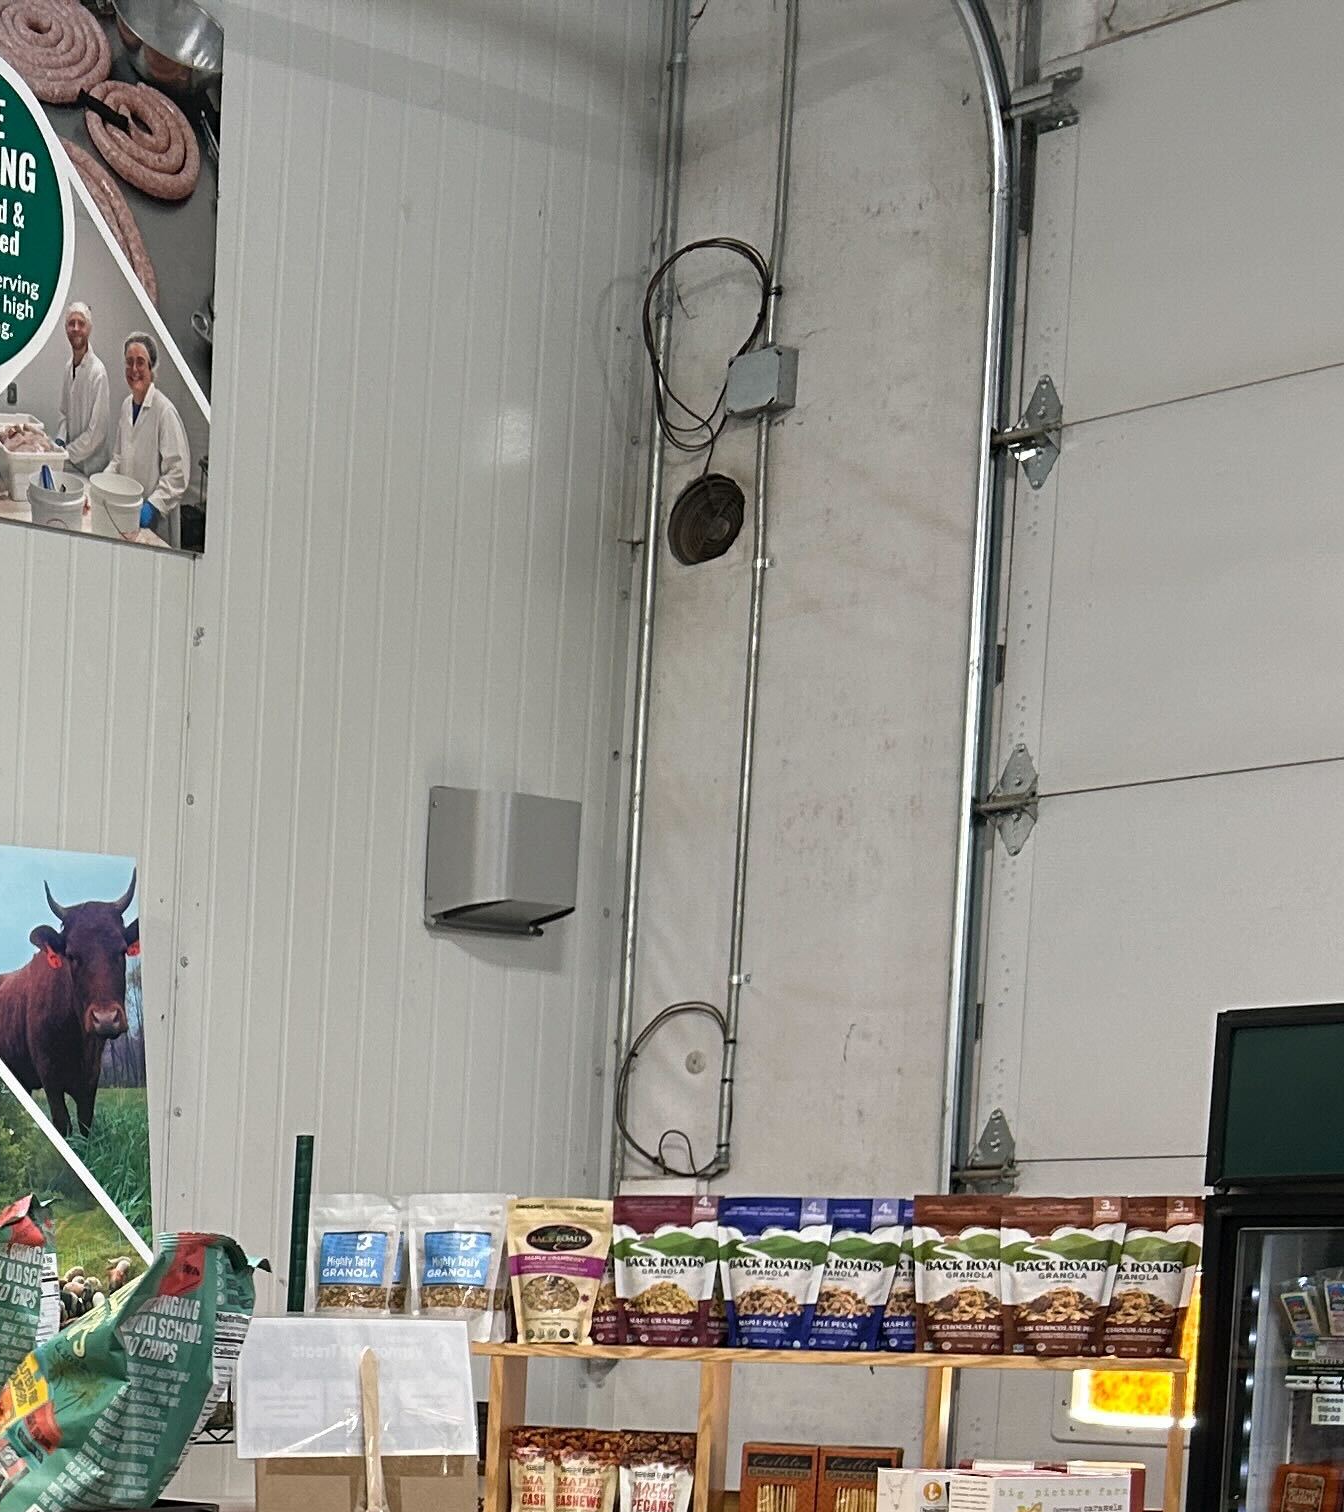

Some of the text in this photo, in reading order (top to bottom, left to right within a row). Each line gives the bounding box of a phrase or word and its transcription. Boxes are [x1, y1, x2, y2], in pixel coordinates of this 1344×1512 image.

[14, 202, 25, 229] &
[3, 294, 34, 319] high
[327, 1256, 375, 1268] Mighty Tasty
[459, 1256, 479, 1268] Tasty
[625, 1257, 704, 1268] BACK ROADS
[729, 1259, 811, 1270] BACK ROADS
[835, 1260, 882, 1272] ROADS
[926, 1260, 966, 1272] BACK
[1016, 1261, 1108, 1272] BACK ROADS
[1129, 1262, 1182, 1272] ROADS
[322, 1268, 378, 1278] GRANOLA
[427, 1268, 481, 1278] GRANOLA
[138, 1339, 178, 1363] CHIPS
